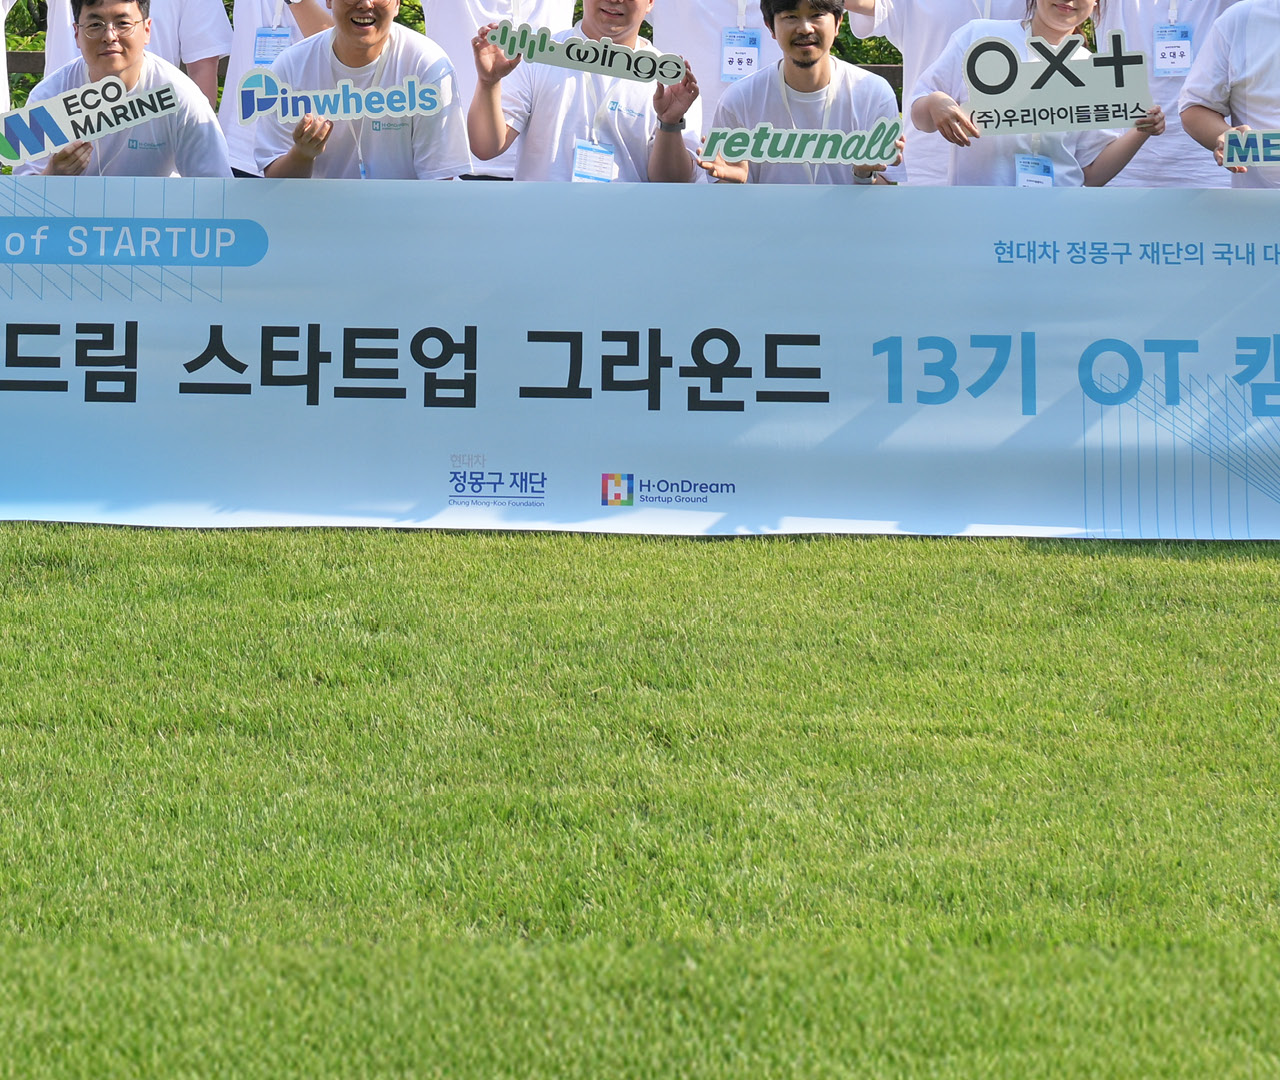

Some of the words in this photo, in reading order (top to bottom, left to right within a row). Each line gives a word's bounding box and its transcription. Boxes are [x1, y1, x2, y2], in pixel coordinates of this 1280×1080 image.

[63, 80, 122, 115] ECO
[70, 88, 176, 139] MARINE
[969, 101, 1147, 129] (주)우리아이들플러스
[703, 123, 898, 161] returnall
[5, 225, 48, 256] of
[67, 226, 236, 259] STARTUP
[994, 240, 1060, 266] 현대차
[1066, 240, 1132, 266] 정몽구
[1139, 240, 1204, 266] 재단의
[1211, 241, 1256, 267] 국내
[179, 322, 478, 408] 스타트업
[519, 326, 829, 412] 그라운드
[871, 331, 1037, 416] 13기
[1078, 338, 1199, 406] OT
[450, 454, 486, 468] 현대차
[449, 471, 504, 494] 정몽구
[509, 471, 547, 494] 재단
[448, 498, 470, 508] Chung
[471, 498, 507, 508] Mong-Koo
[508, 499, 545, 508] Foundation
[639, 494, 674, 505] Startup
[675, 495, 708, 505] Ground
